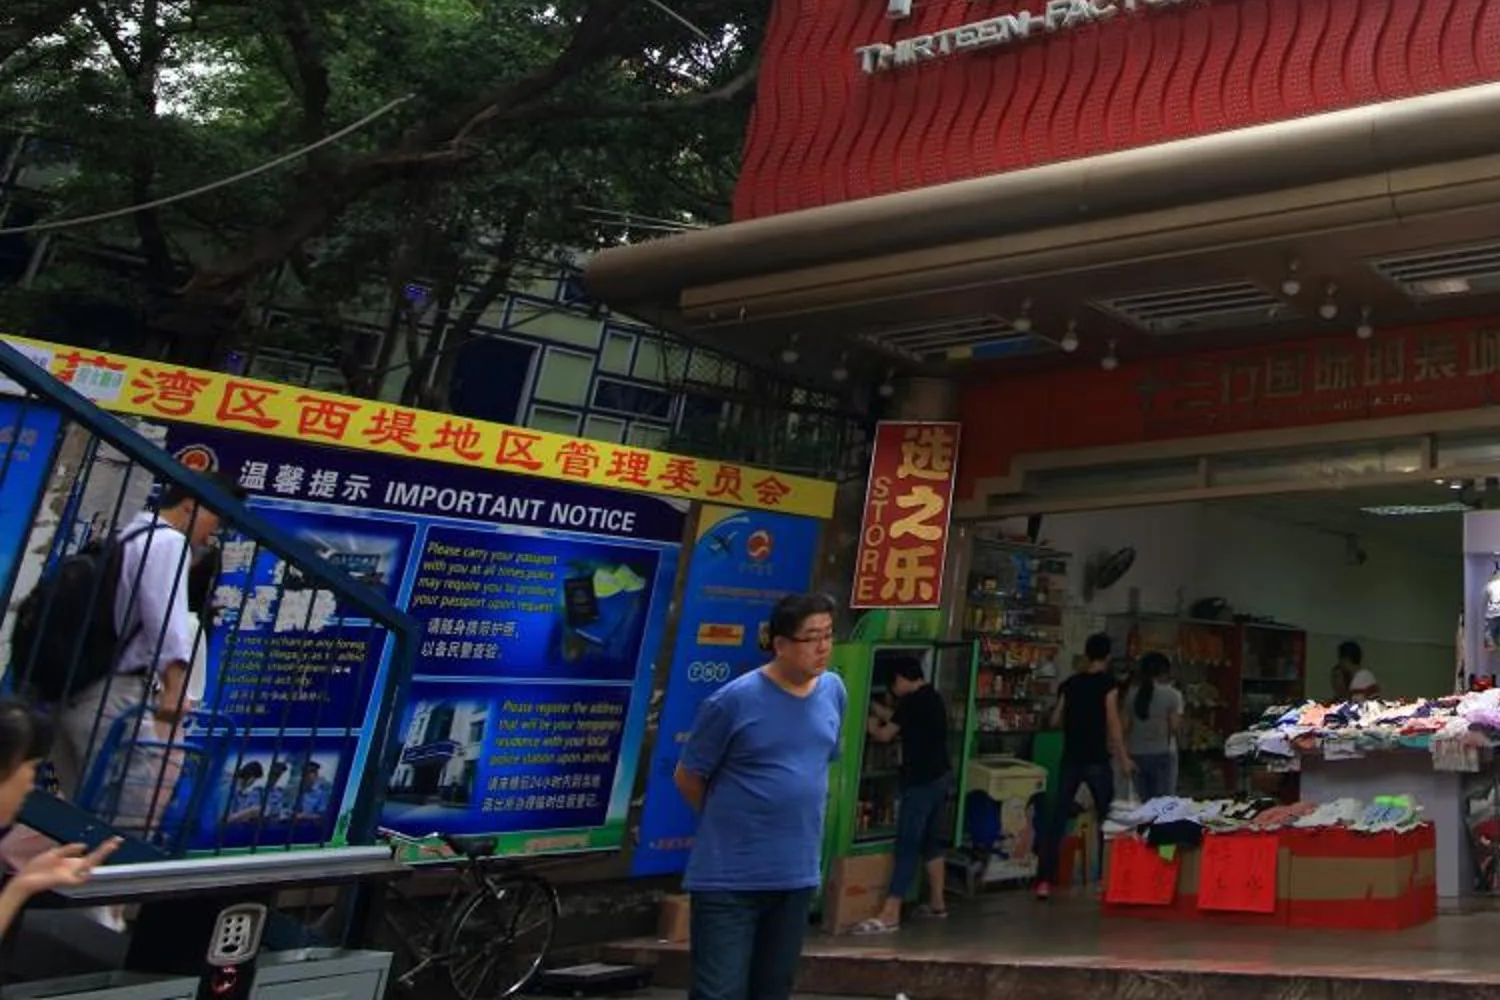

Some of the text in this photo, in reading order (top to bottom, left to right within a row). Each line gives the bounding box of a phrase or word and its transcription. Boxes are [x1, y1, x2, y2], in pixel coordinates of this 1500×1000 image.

[238, 459, 372, 502] 温馨提示
[383, 479, 638, 533] IMPORTANT NOTICE
[427, 541, 462, 557] Please
[857, 475, 891, 601] STORE
